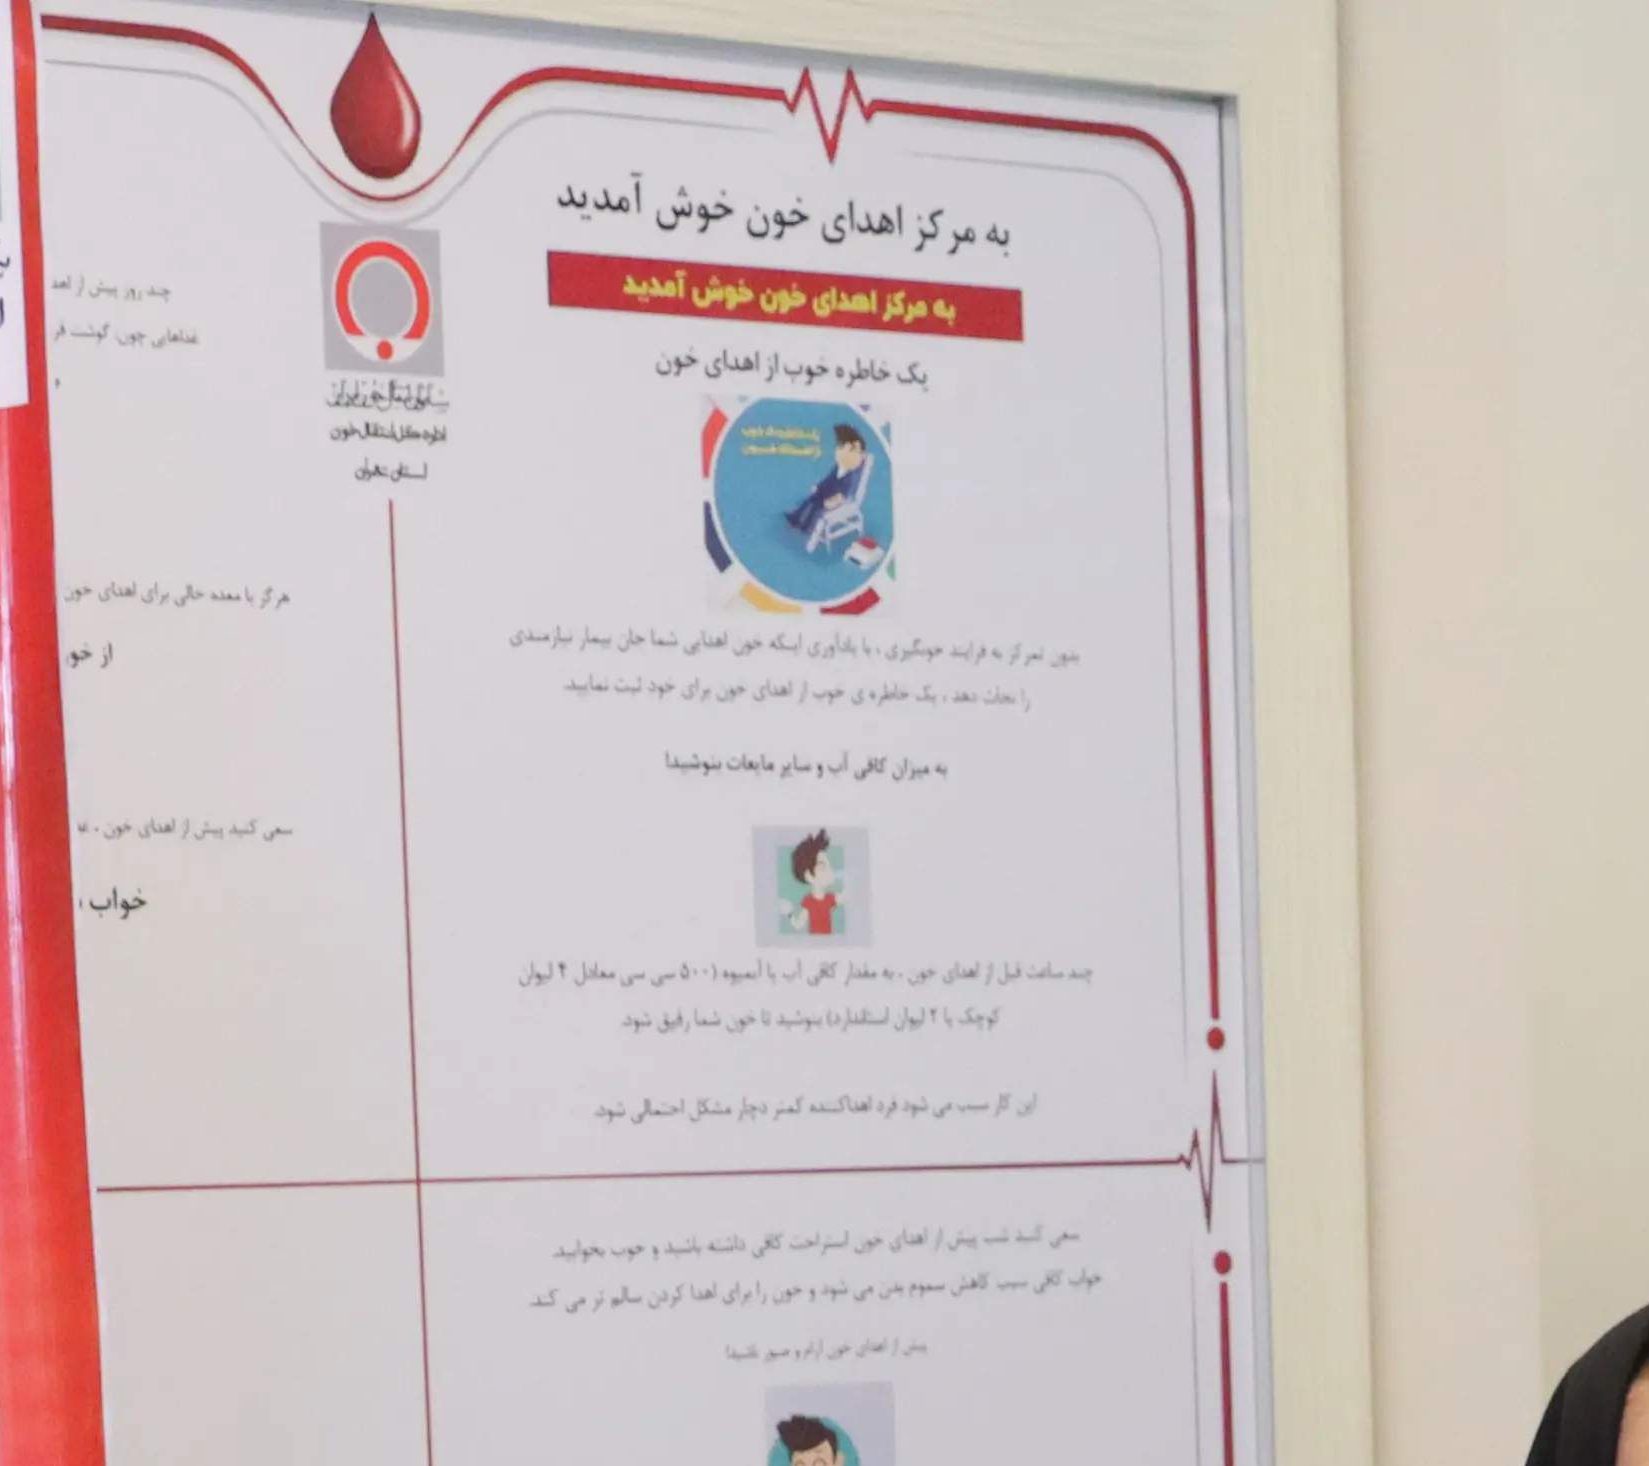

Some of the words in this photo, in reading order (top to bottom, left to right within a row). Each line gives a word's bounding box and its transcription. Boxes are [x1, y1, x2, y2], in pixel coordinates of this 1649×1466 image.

[557, 172, 642, 221] آمدید
[656, 184, 734, 234] خوش
[747, 196, 810, 240] خون
[821, 199, 902, 244] اهدای
[914, 208, 975, 256] مرکز
[985, 222, 1011, 258] به
[51, 275, 71, 288] اهد
[623, 269, 687, 303] آمدید
[691, 274, 754, 311] خوش
[760, 282, 808, 314] خون
[812, 286, 878, 318] اهدای
[882, 289, 928, 324] مرکز
[932, 298, 956, 326] به
[655, 346, 698, 376] خون
[705, 348, 759, 378] اهدای
[764, 352, 778, 382] از
[783, 356, 829, 385] خوب
[835, 357, 890, 388] خاطره
[896, 360, 929, 392] یک
[66, 642, 92, 668] خو
[100, 642, 113, 668] از
[726, 753, 774, 775] مایعات
[780, 754, 810, 779] سایر
[817, 762, 823, 779] و
[827, 750, 849, 775] آب
[854, 756, 886, 780] کافی
[892, 758, 930, 781] میزان
[936, 761, 948, 781] به
[90, 886, 147, 920] خواب
